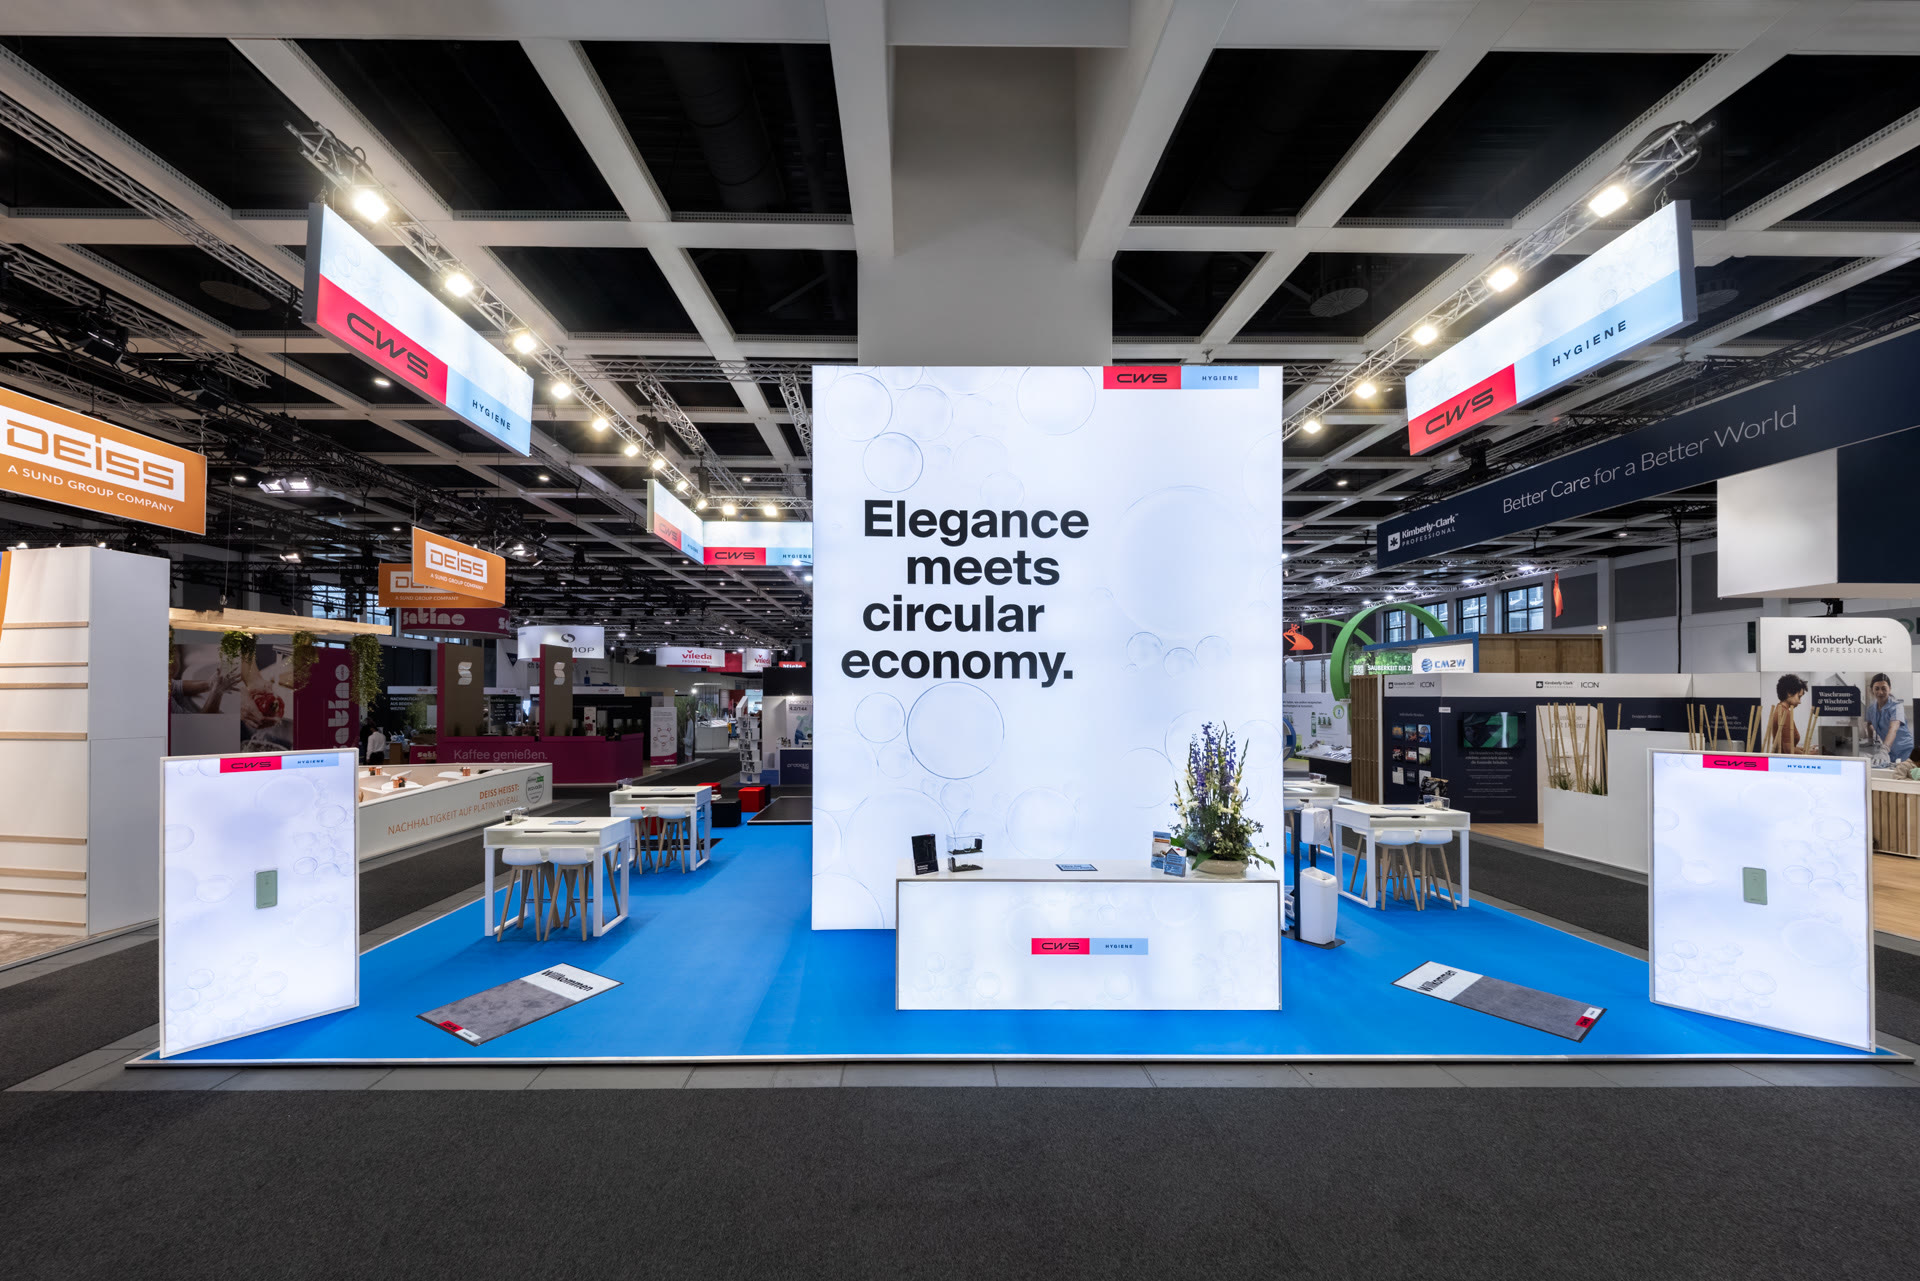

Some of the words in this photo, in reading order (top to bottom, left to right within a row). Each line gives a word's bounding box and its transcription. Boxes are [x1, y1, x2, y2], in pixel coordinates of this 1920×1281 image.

[347, 312, 429, 380] CWS
[472, 399, 511, 431] HYGIENE
[1116, 373, 1168, 384] CWS
[1425, 387, 1494, 435] CWS
[1552, 320, 1628, 367] HYGIENE
[1502, 487, 1548, 514] Better
[1550, 473, 1591, 498] Care
[1594, 464, 1621, 487] for
[1624, 462, 1636, 476] a
[1641, 436, 1710, 472] Better
[1713, 404, 1797, 448] World
[8, 464, 18, 475] A
[22, 473, 64, 486] SUND
[67, 480, 114, 498] GROUP
[117, 492, 174, 513] COMPANY
[659, 522, 678, 542] CWS
[864, 499, 1089, 547] Elegance
[1401, 526, 1456, 548] PROFESSIONAL
[714, 551, 755, 560] CWS
[907, 550, 1060, 586] meets
[434, 574, 448, 583] SUND
[448, 577, 464, 587] GROUP
[463, 581, 484, 591] COMPANY
[862, 594, 1045, 633] circular
[682, 650, 713, 660] vileda
[1434, 659, 1466, 669] CM2W
[841, 649, 1073, 688] economy.
[1367, 664, 1398, 672] SAUBERKEIT
[1580, 681, 1600, 689] ICON
[327, 664, 350, 749] atino
[231, 761, 272, 769] CWS
[454, 749, 490, 760] Kaffee
[493, 749, 548, 762] genießen.
[1713, 760, 1757, 768] CWS
[479, 786, 498, 800] DEISS
[498, 783, 520, 796] HEISST:
[387, 810, 457, 836] NACHHALTIGKEIT
[458, 806, 473, 818] AUF
[1041, 942, 1080, 951] CWS
[541, 969, 594, 993] Willkommen
[1417, 969, 1457, 993] Willkommen
